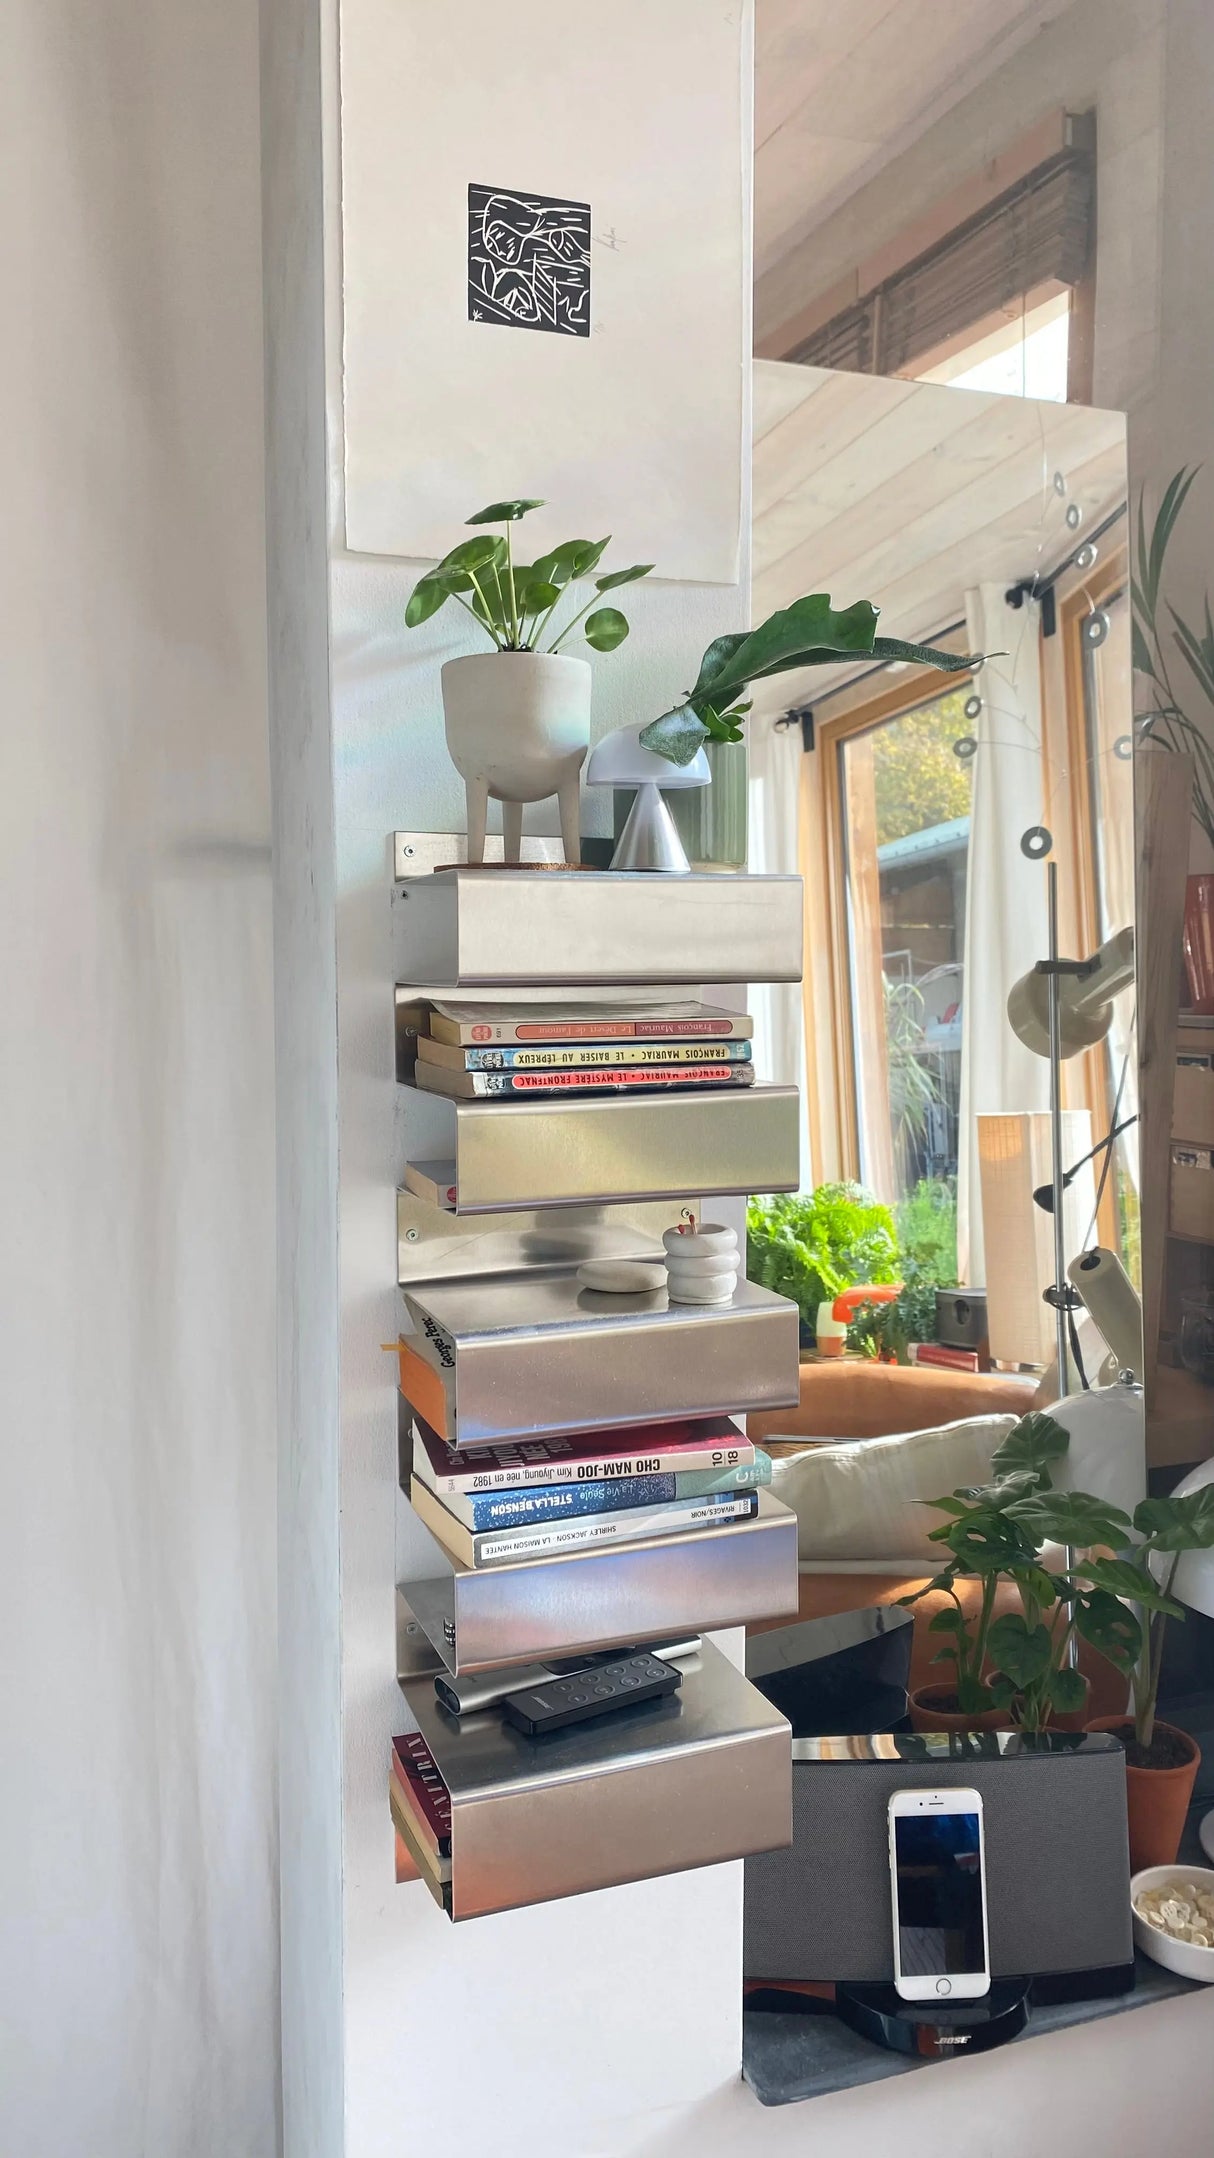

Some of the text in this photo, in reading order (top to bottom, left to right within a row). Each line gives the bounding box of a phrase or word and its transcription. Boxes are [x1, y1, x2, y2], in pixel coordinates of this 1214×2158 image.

[575, 1026, 587, 1034] de
[621, 1025, 632, 1033] Le
[640, 1022, 712, 1033] François Mauriac
[518, 1048, 725, 1065] FRANÇOIS MAURIAC LE BAISER AU LÉPREUX
[618, 1072, 627, 1082] LE
[432, 1338, 455, 1368] Georges
[544, 1438, 574, 1453] 198
[712, 1452, 723, 1467] 10
[728, 1450, 739, 1465] 18
[577, 1459, 660, 1479] CHO NAM-JOO
[473, 1467, 572, 1487] Kim Jiyoung, née en 1982
[491, 1493, 573, 1517] STELLA BENSON
[691, 1505, 735, 1518] RIVAGES/NOIR
[556, 1530, 588, 1542] JACKSON
[590, 1525, 617, 1536] SHIRLEY
[514, 1540, 541, 1549] MAISON
[934, 2035, 972, 2045] BOSE
